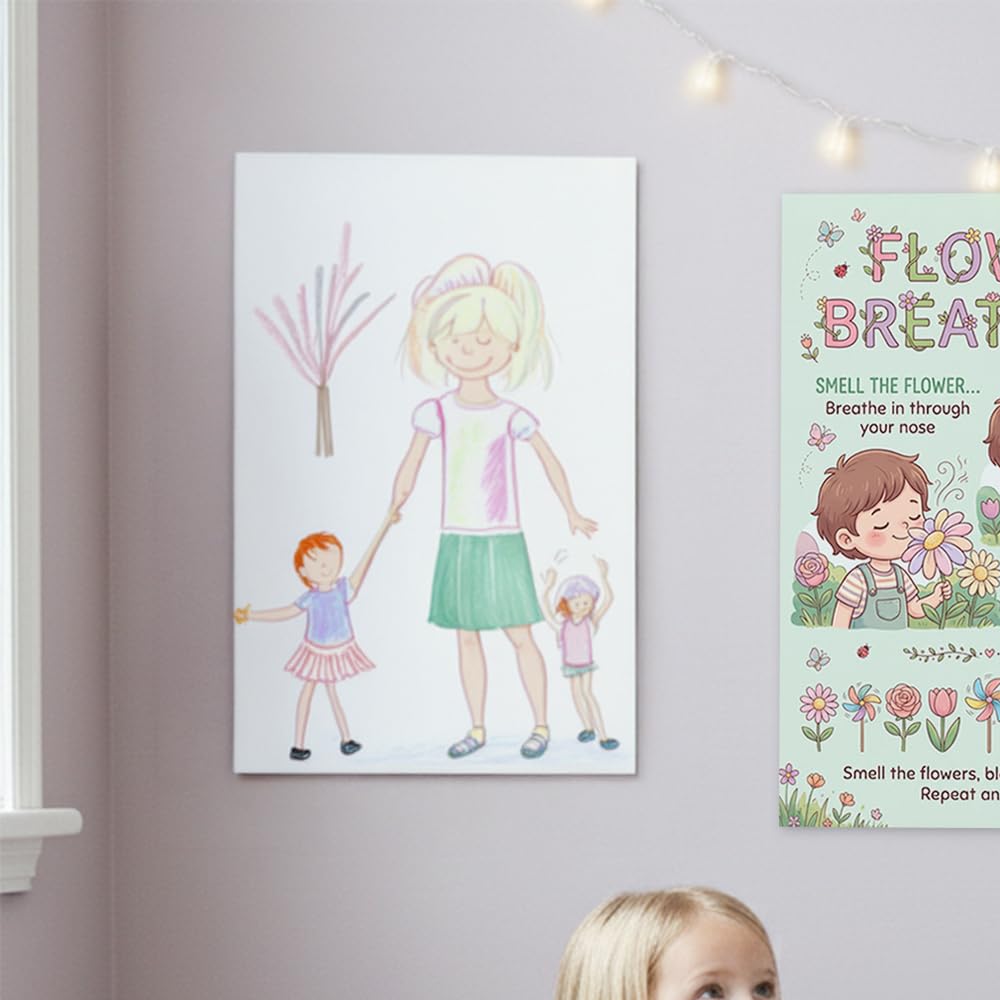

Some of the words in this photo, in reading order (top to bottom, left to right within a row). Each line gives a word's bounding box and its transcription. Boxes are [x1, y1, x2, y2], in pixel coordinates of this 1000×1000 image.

[815, 376, 865, 395] SMELL
[869, 376, 899, 394] THE
[904, 376, 981, 395] FLOWER...
[825, 399, 887, 416] Breathe
[891, 400, 905, 416] in
[909, 399, 971, 418] through
[859, 422, 895, 438] your
[899, 422, 936, 435] nose
[842, 764, 886, 781] Smell
[889, 765, 916, 781] the
[919, 764, 981, 783] flowers,
[920, 786, 977, 805] Repeat
